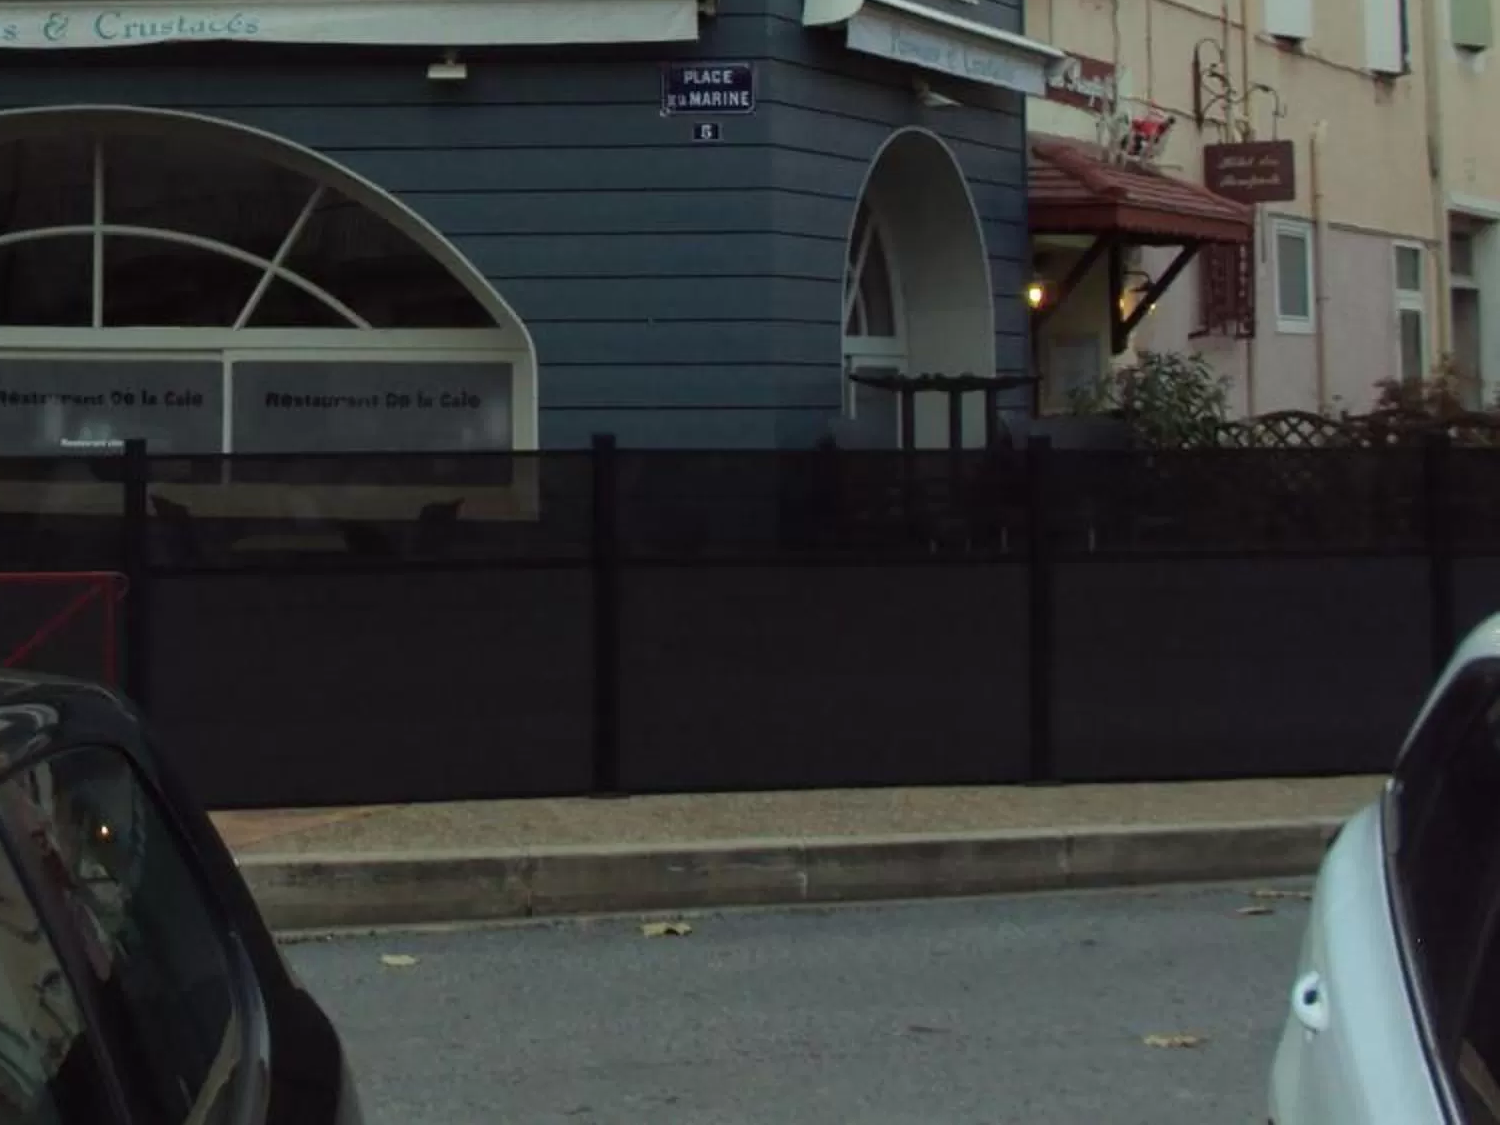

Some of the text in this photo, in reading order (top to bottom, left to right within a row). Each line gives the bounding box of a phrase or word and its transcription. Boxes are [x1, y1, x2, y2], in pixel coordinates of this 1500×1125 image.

[42, 13, 70, 42] &
[93, 12, 260, 41] Crustacés
[683, 70, 733, 84] PLACE
[689, 90, 750, 108] MARINE
